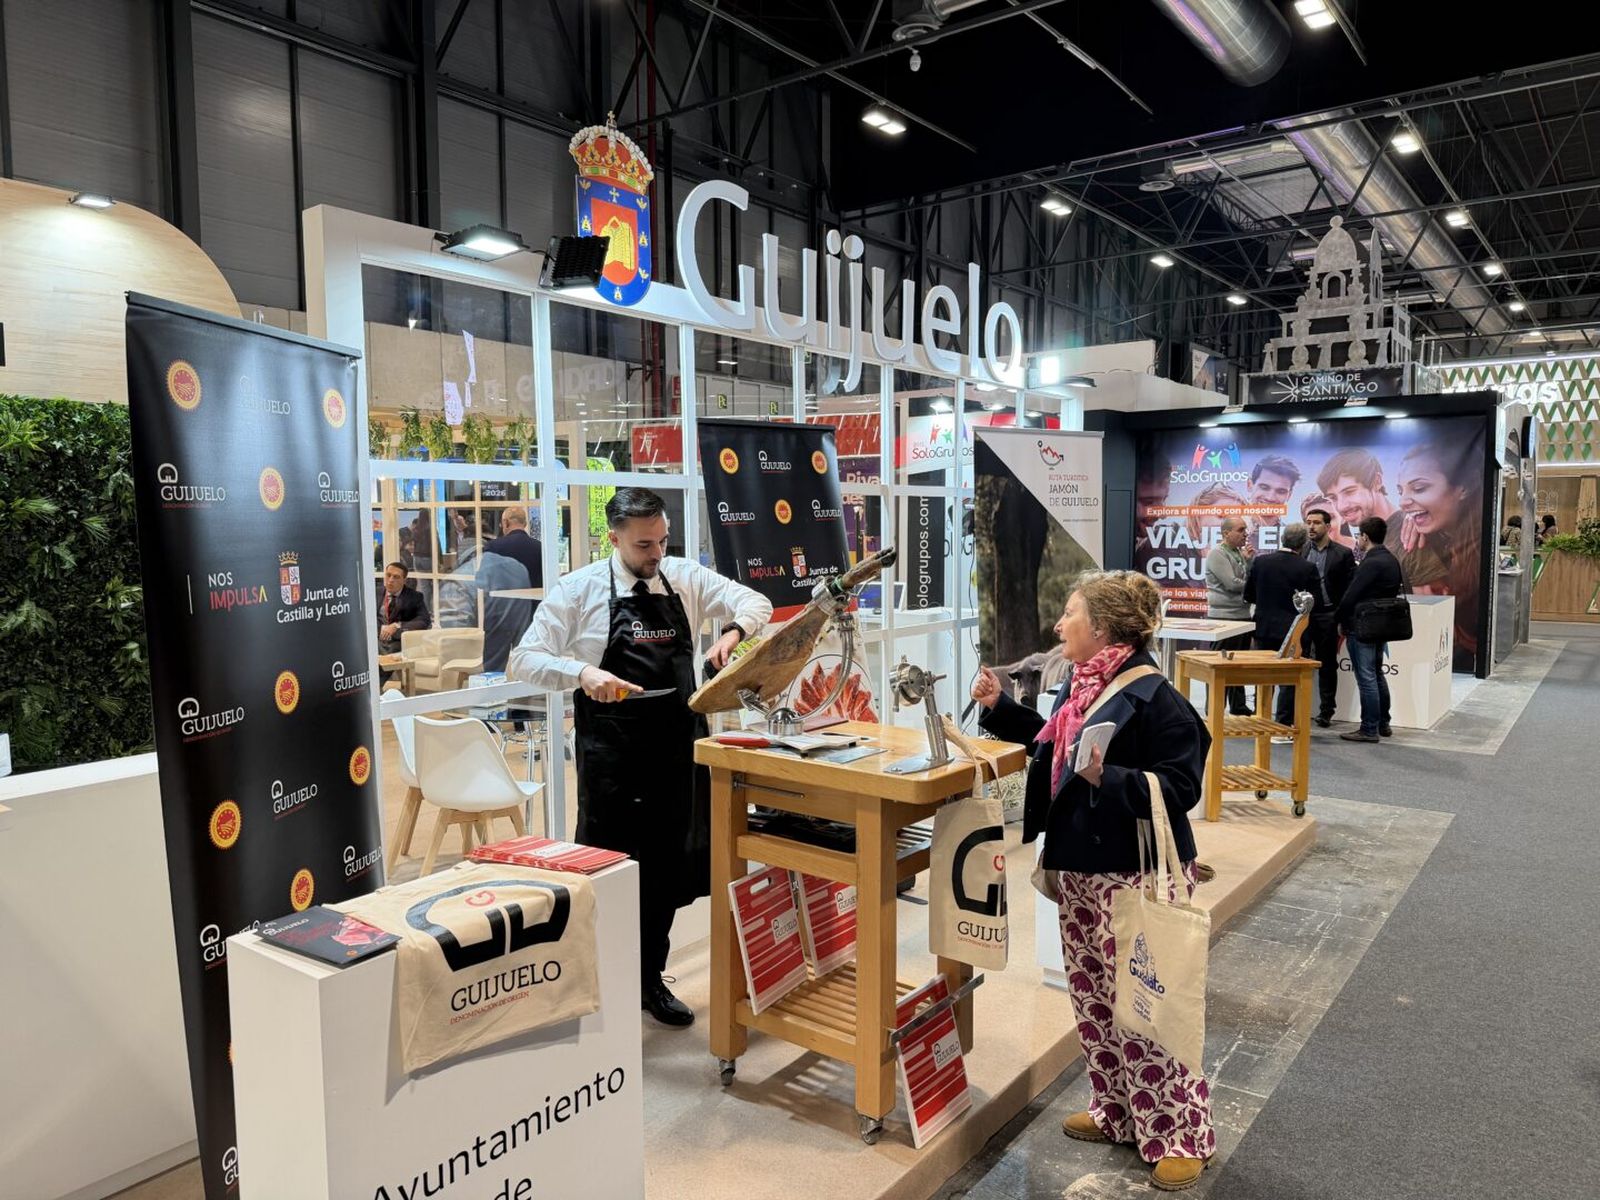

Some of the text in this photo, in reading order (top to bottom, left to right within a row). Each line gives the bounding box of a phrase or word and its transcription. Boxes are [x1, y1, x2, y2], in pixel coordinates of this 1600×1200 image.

[677, 180, 1024, 393] Guijuelo
[1301, 373, 1361, 385] CAMINO DE
[1301, 382, 1379, 396] SANTIAGO
[912, 446, 974, 461] SoloGruos
[761, 462, 792, 471] GUIJUELO
[1170, 470, 1249, 485] SoloGrupos
[160, 486, 226, 501] GUIJUELO
[1049, 483, 1079, 494] JAMÓN
[1049, 498, 1099, 507] DE GUIJUELO
[719, 511, 756, 522] GUIJUELO
[1147, 507, 1180, 517] Explora
[1181, 507, 1189, 515] el
[1191, 506, 1223, 515] mundo
[1243, 506, 1285, 515] nosotros
[1145, 526, 1223, 549] VIAJE
[747, 558, 763, 567] NOS
[1146, 556, 1207, 581] GRU
[808, 565, 838, 576] Junta de
[208, 572, 233, 587] NOS
[791, 577, 817, 588] Castilla
[304, 585, 349, 603] Junta de
[1174, 589, 1188, 598] los
[277, 601, 350, 624] Castilla y León
[633, 628, 676, 639] GUIJUELO
[181, 706, 245, 735] GUIJUELO
[273, 783, 318, 814] GUIJUELO
[957, 921, 1005, 943] GUIJU
[451, 960, 562, 1012] GUIJUELO
[371, 1066, 626, 1200] Ayuntamiento
